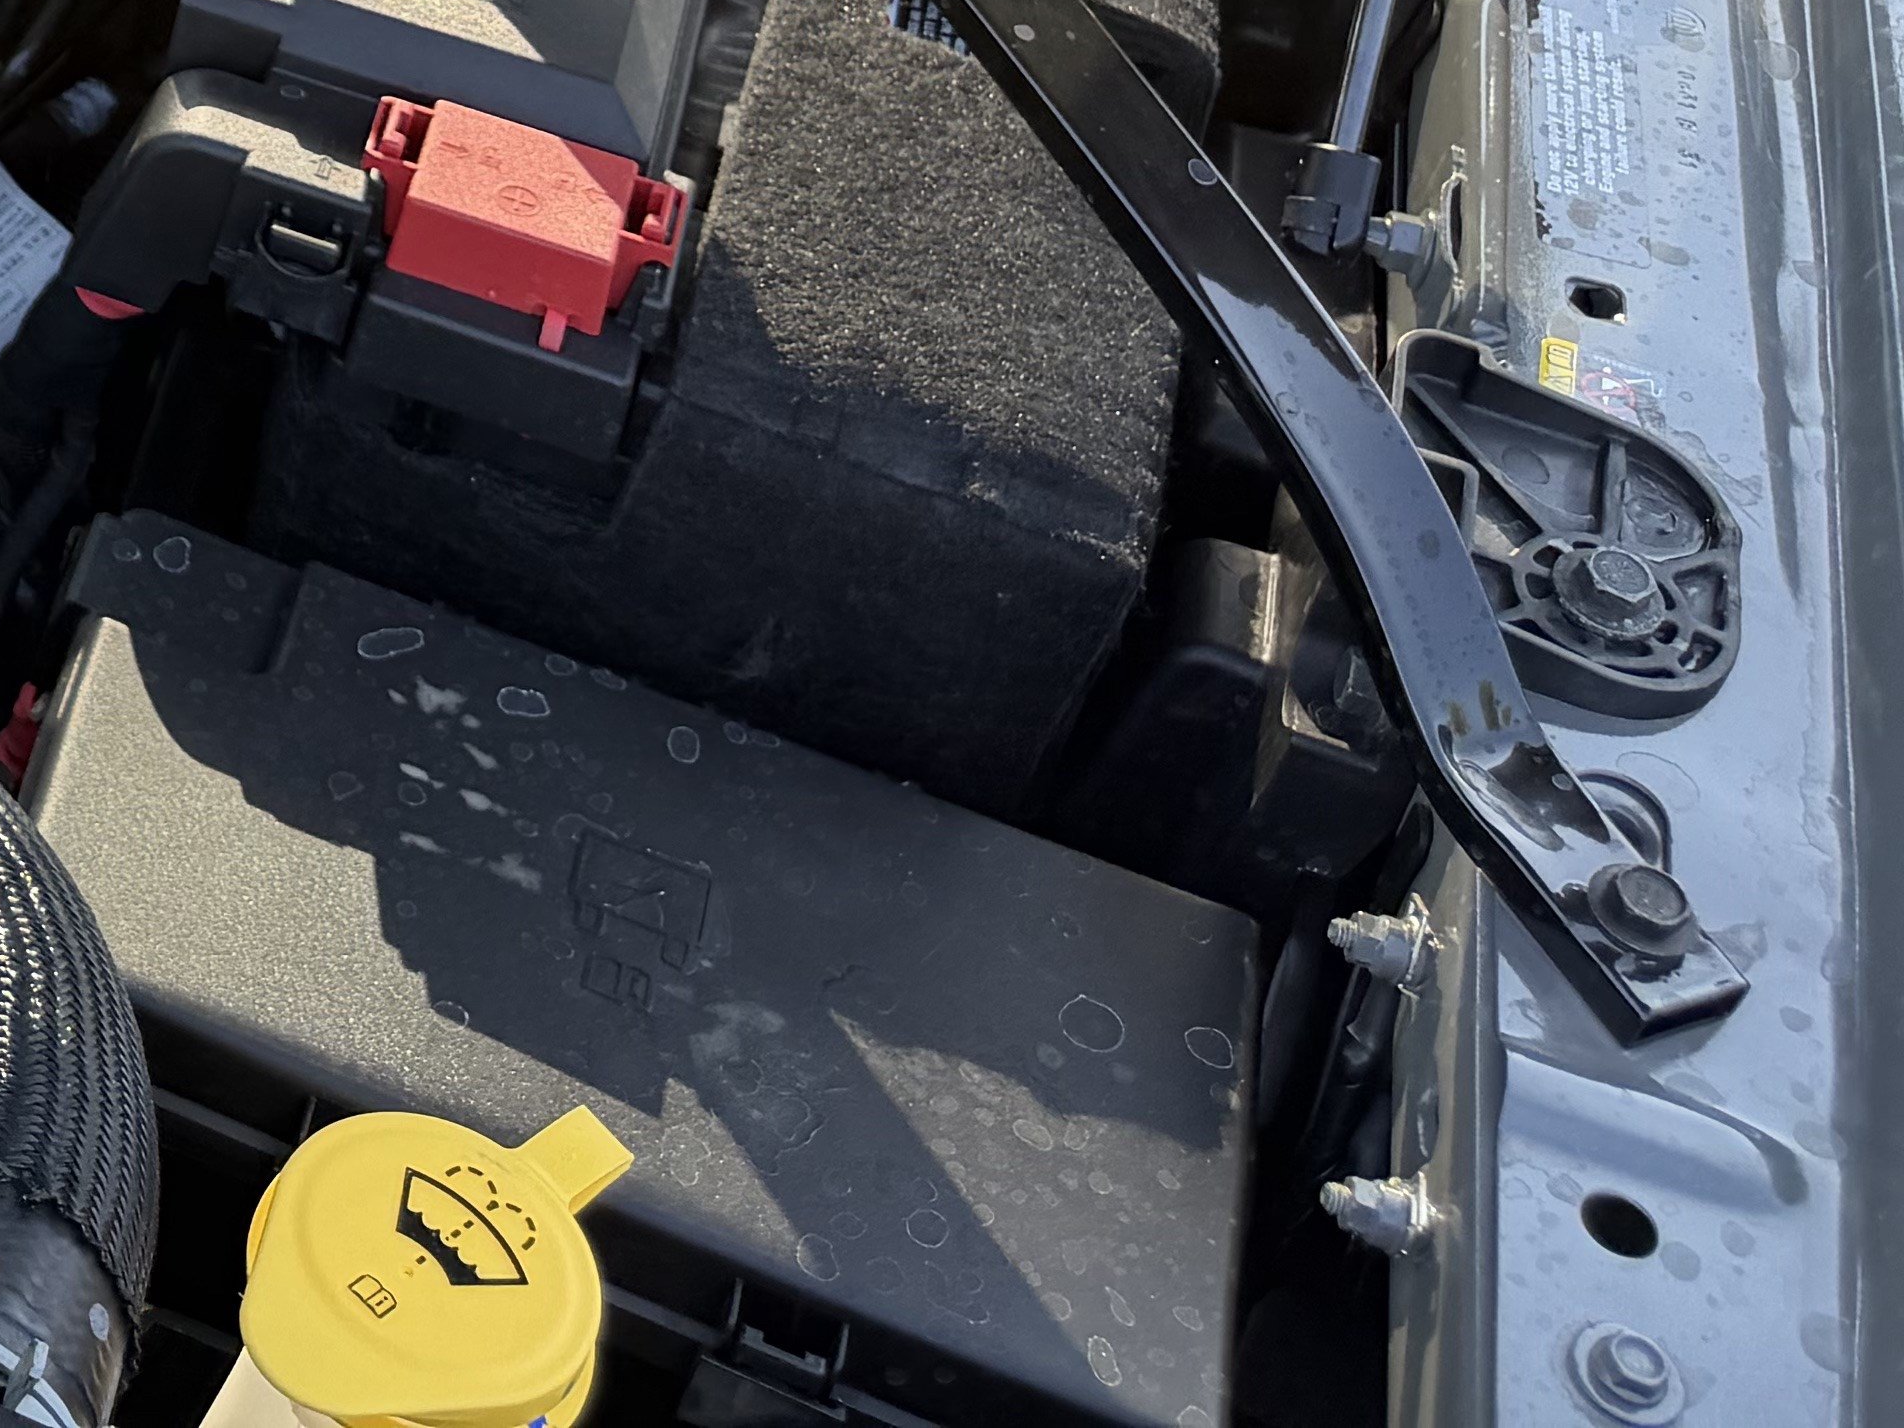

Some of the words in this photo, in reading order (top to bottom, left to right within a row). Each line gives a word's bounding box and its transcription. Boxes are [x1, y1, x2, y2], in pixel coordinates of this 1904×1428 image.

[1548, 149, 1560, 169] not
[1547, 177, 1562, 193] Do
[1564, 169, 1579, 195] 12V
